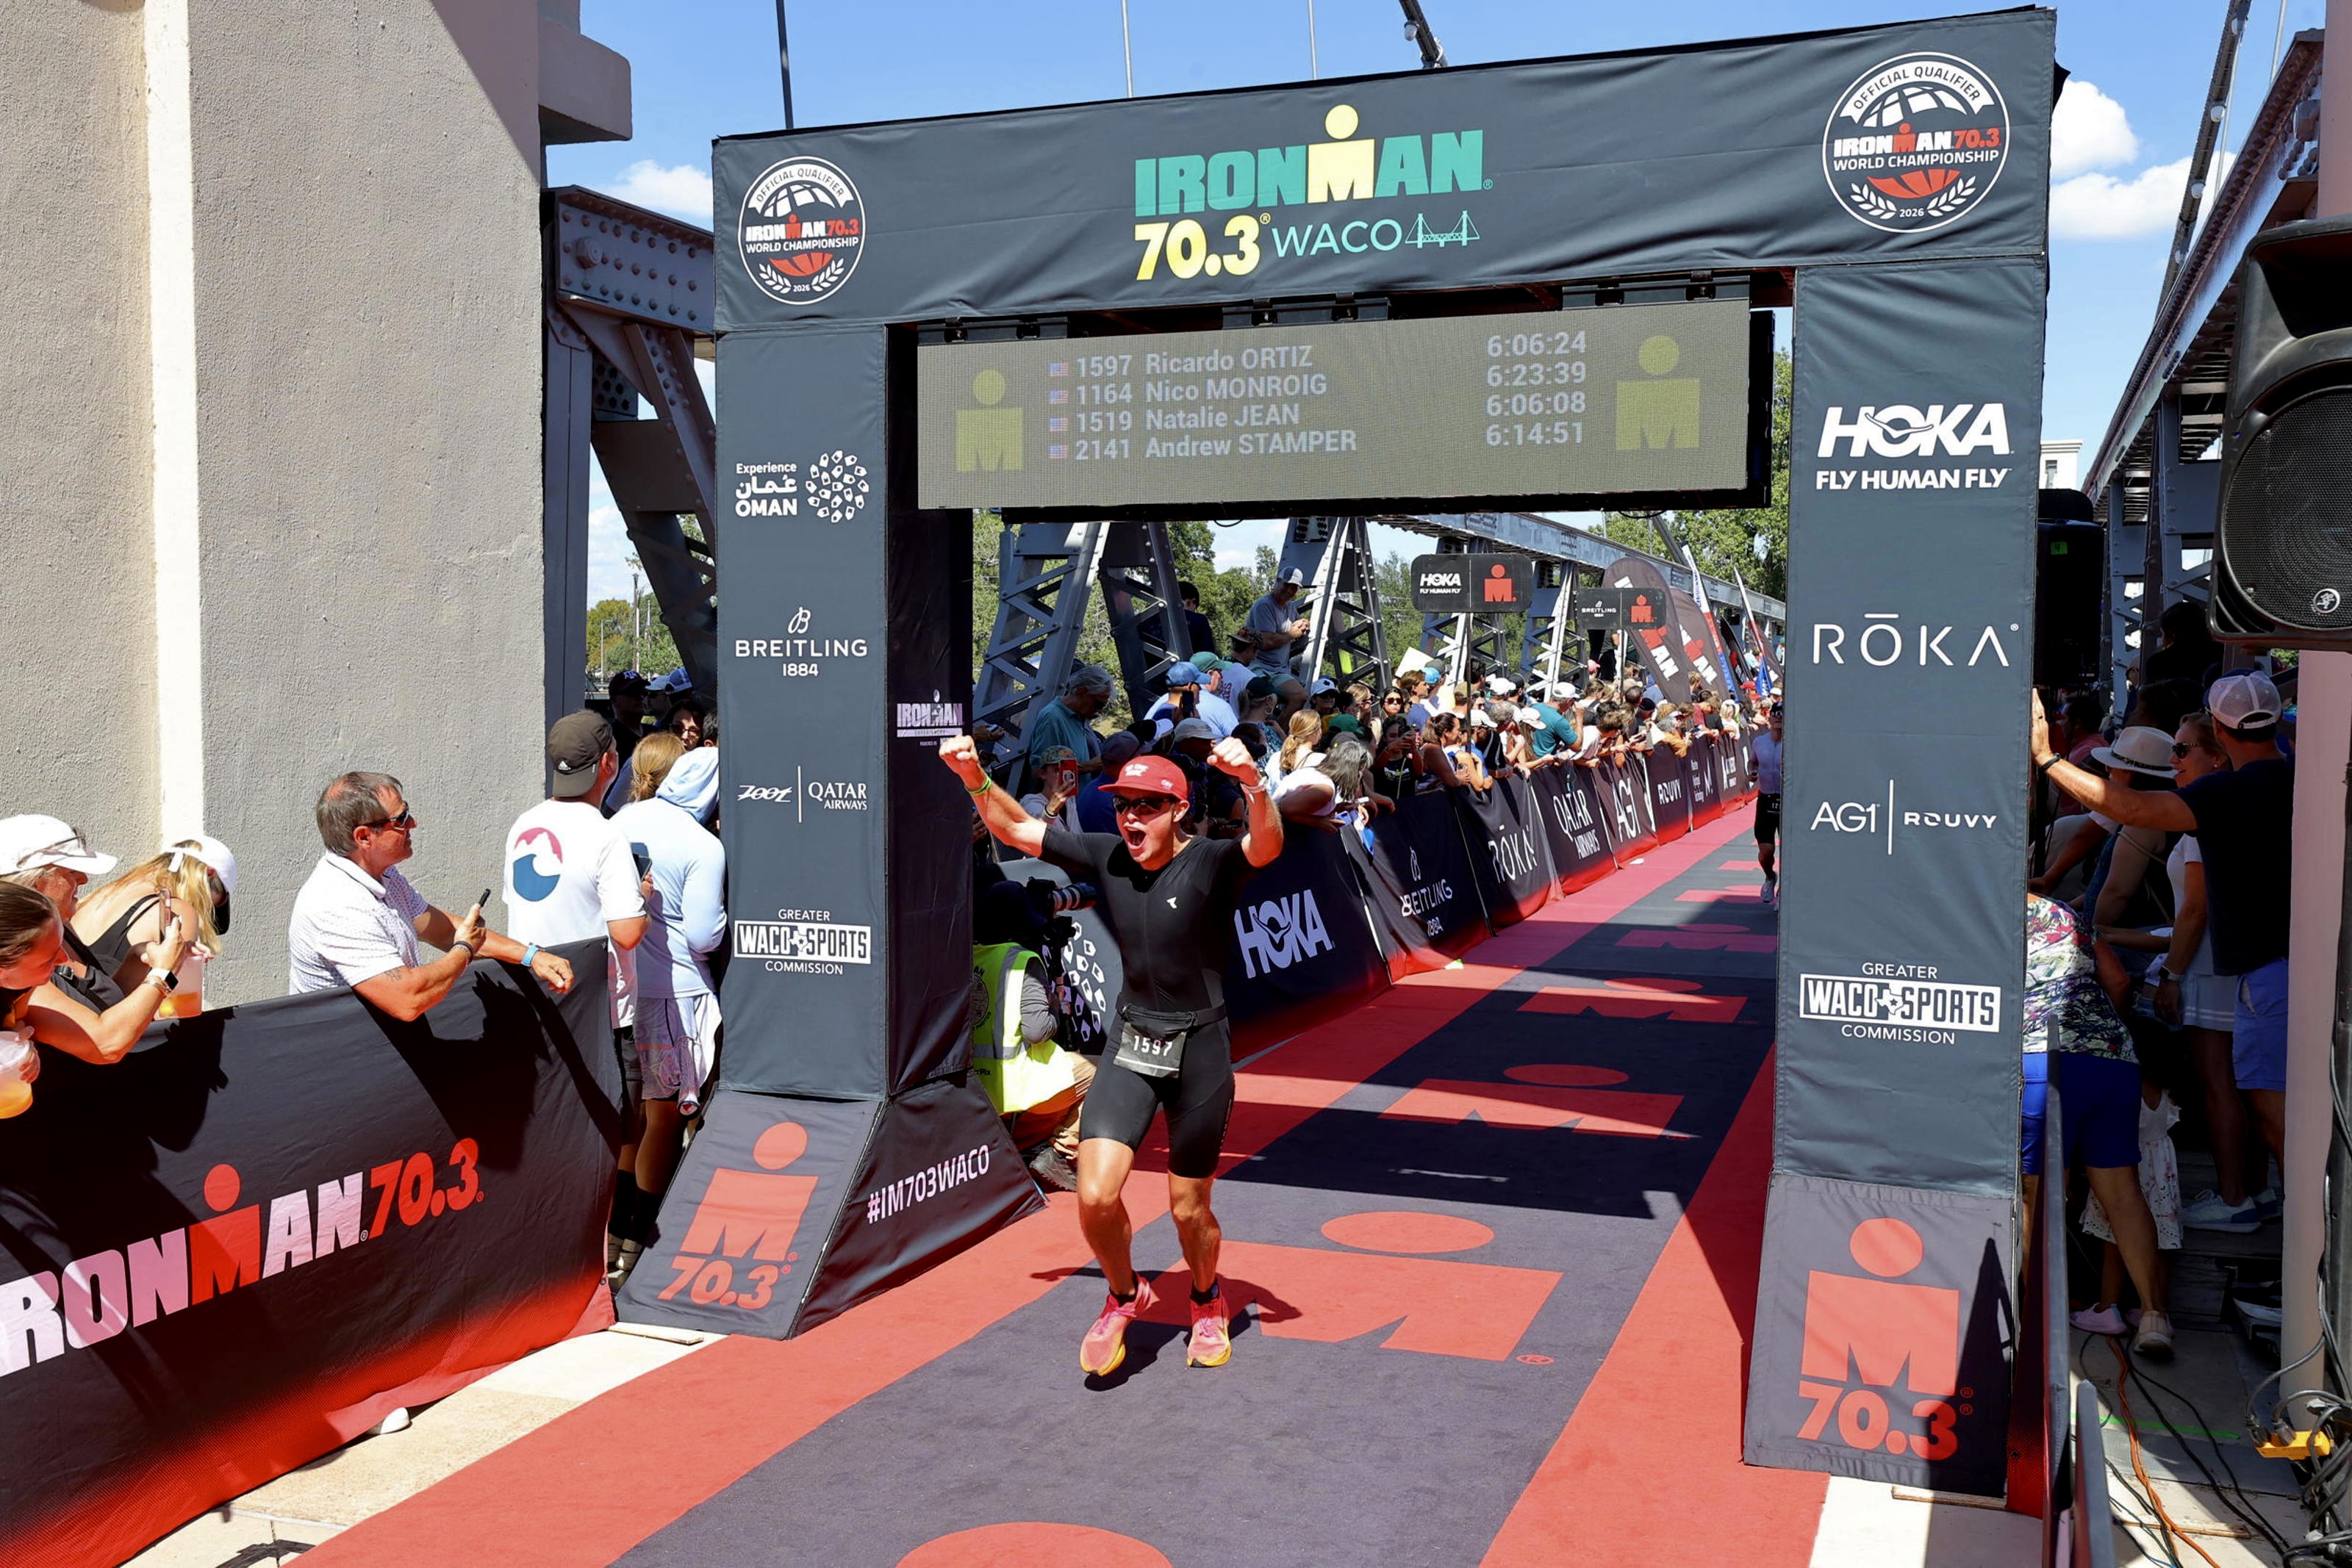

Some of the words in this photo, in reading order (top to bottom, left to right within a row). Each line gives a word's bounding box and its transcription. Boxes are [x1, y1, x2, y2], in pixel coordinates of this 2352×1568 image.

[1854, 68, 1910, 109] OFFICIAL
[1914, 66, 1980, 101] QUALIFIER
[1834, 123, 1952, 157] IRONMAN
[1954, 127, 2000, 148] 70.3
[1135, 104, 1483, 217] IRONMAN
[1834, 157, 1885, 170] WORLD
[1888, 149, 1998, 167] CHAMPIONSHIP
[756, 170, 794, 202] OFFICIAL
[797, 168, 845, 196] QUALIFIER
[1899, 208, 1924, 217] 2026
[745, 214, 826, 242] IRONMAN
[827, 218, 859, 236] 70.3
[746, 242, 781, 253] WORLD
[784, 237, 858, 251] CHAMPIONSHIP
[1134, 215, 1261, 281] 70.3
[1272, 218, 1402, 258] WACO
[1487, 331, 1587, 357] 6:06:24
[1076, 354, 1133, 378] 1597
[1146, 348, 1234, 375] Ricardo
[1241, 345, 1313, 369] ORTIZ
[1487, 361, 1587, 387] 6:23:39
[1076, 382, 1133, 406] 1164
[1145, 378, 1199, 403] Nico
[1206, 374, 1327, 400] MONROIG
[1486, 391, 1586, 417] 6:06:08
[1076, 410, 1133, 433] 1519
[1145, 406, 1227, 431] Natalie
[1234, 403, 1299, 428] JEAN
[1817, 403, 2010, 458] HOKA
[1075, 439, 1130, 461] 2141
[1144, 435, 1230, 458] Andrew
[1238, 430, 1357, 455] STAMPER
[1486, 421, 1583, 447] 6:14:51
[736, 463, 797, 476] Experience
[1815, 470, 1857, 490] FLY
[1860, 468, 1960, 490] HUMAN
[1965, 468, 2007, 489] FLY
[735, 498, 797, 517] OMAN
[1420, 573, 1461, 586] HOKA
[735, 639, 868, 658] BREITLING
[783, 663, 819, 677] 1884
[897, 689, 964, 727] IRONMAN
[808, 782, 867, 801] QATAR
[1657, 779, 1682, 805] ROUVY
[824, 799, 867, 811] AIRWAYS
[1552, 789, 1593, 842] QATAR
[1810, 802, 1876, 832] AG1
[1904, 811, 1997, 828] ROUVY
[778, 908, 831, 921] GREATER
[739, 925, 790, 955] WACO
[806, 927, 867, 959] SPORTS
[1233, 888, 1333, 979] HOKA
[765, 961, 844, 975] COMMISSION
[1862, 962, 1938, 979] GREATER
[1807, 979, 1878, 1018] WACO
[1900, 986, 1994, 1026] SPORTS
[1133, 1035, 1172, 1057] 1597
[1841, 1024, 1955, 1045] COMMISSION
[867, 1144, 991, 1224] #IM703WACO
[0, 1163, 363, 1378] RONMAN
[368, 1137, 478, 1240] 70.3
[656, 1255, 780, 1310] 70.3
[1796, 1380, 1957, 1461] 70.3
